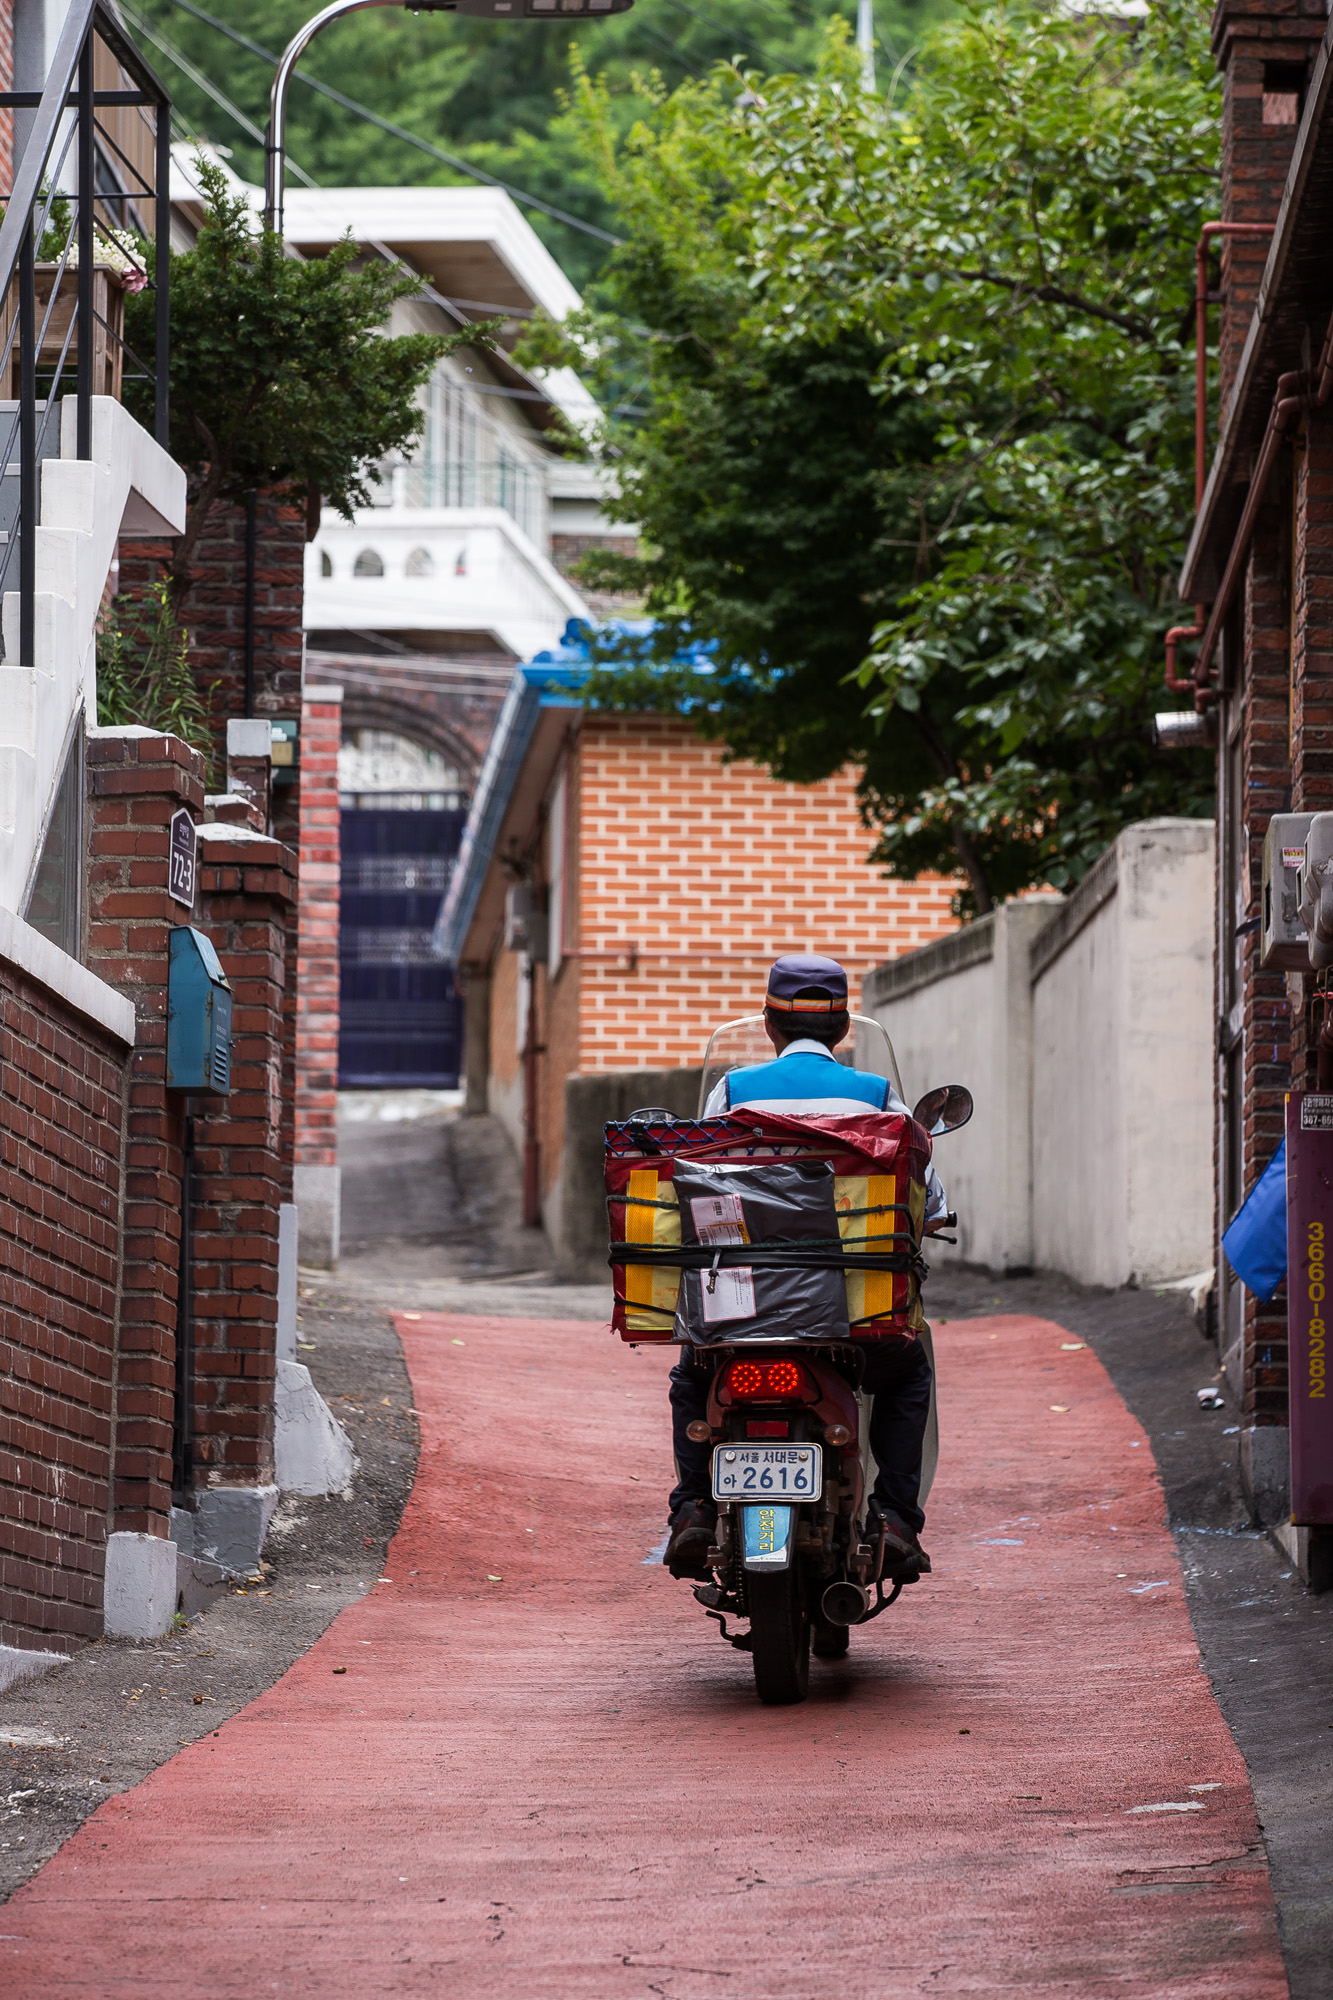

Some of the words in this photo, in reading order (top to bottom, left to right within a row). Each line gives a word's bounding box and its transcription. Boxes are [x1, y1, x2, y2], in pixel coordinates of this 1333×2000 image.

[173, 851, 193, 893] 72-3
[1308, 1222, 1326, 1398] 3660-8282
[723, 1474, 737, 1489] 아
[743, 1467, 808, 1490] 2616
[740, 1452, 760, 1464] 서울
[763, 1451, 798, 1464] 서대문
[758, 1509, 776, 1552] 안전거리
